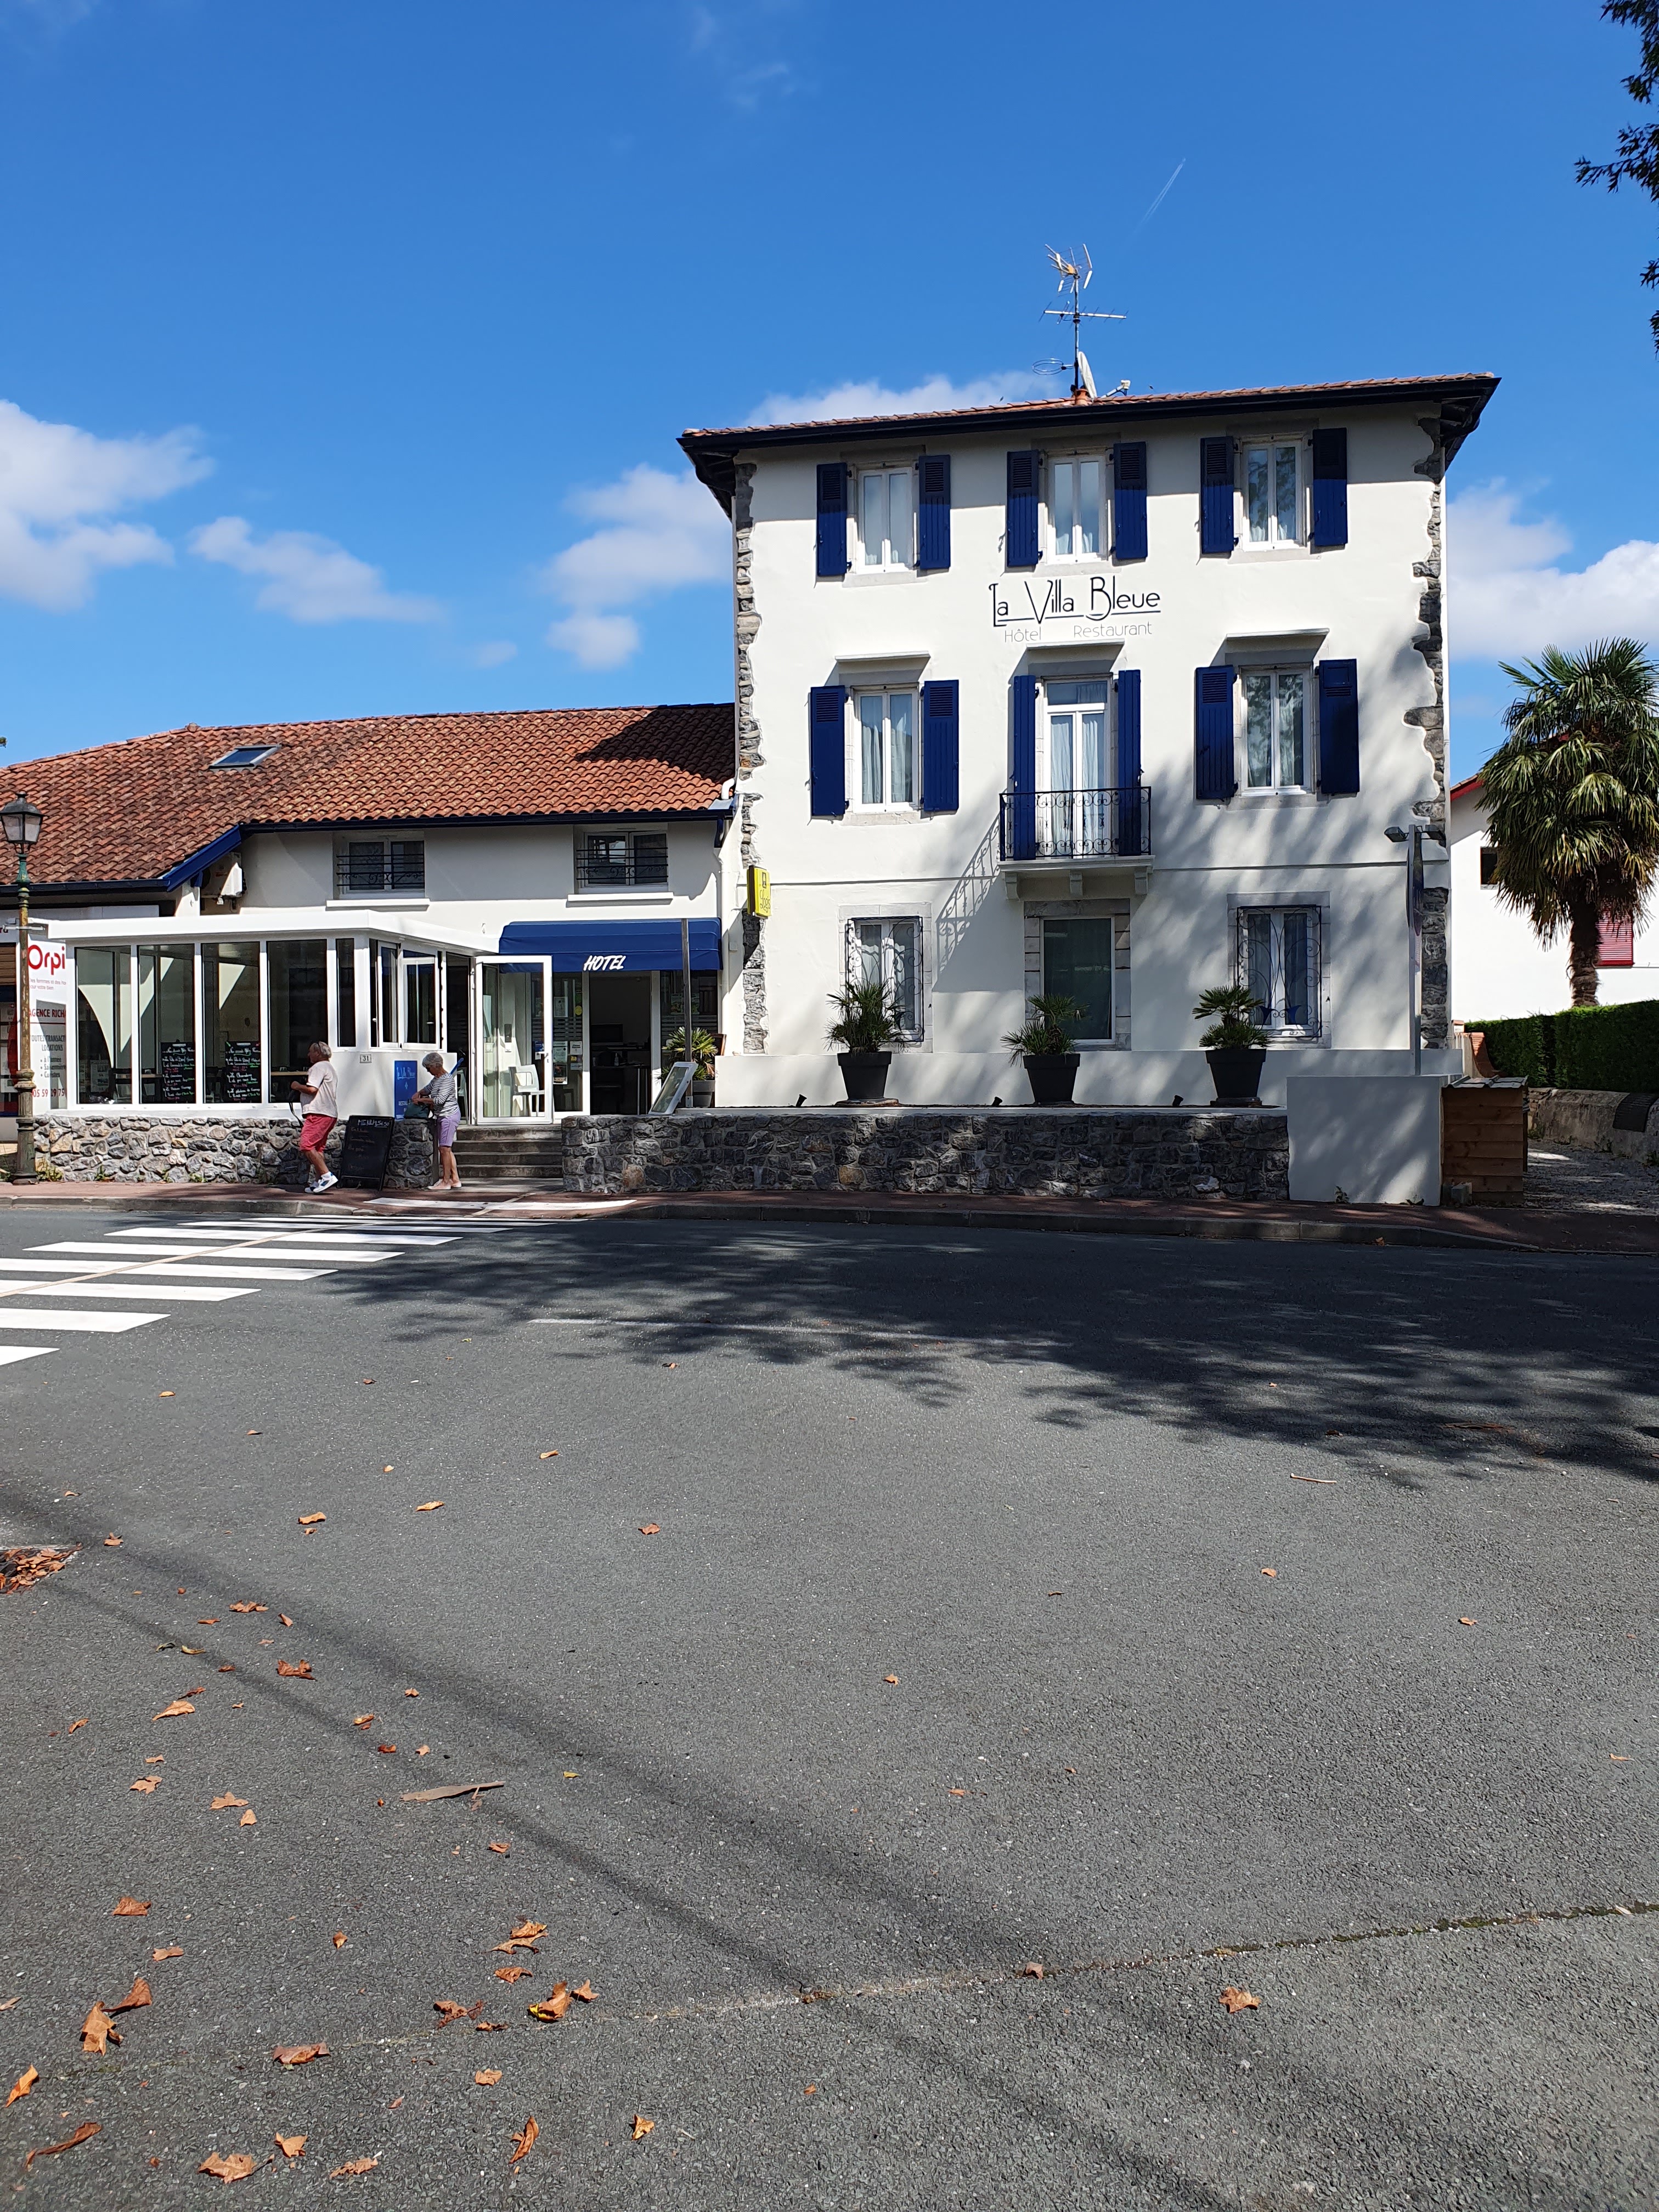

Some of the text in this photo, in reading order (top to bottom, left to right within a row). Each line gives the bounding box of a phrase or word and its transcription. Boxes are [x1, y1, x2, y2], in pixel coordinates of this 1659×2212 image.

[989, 575, 1161, 627] La Villa Bleue
[1004, 621, 1153, 643] Hôtel Restaurant
[27, 945, 65, 975] Orpi
[583, 955, 627, 971] HOTEL
